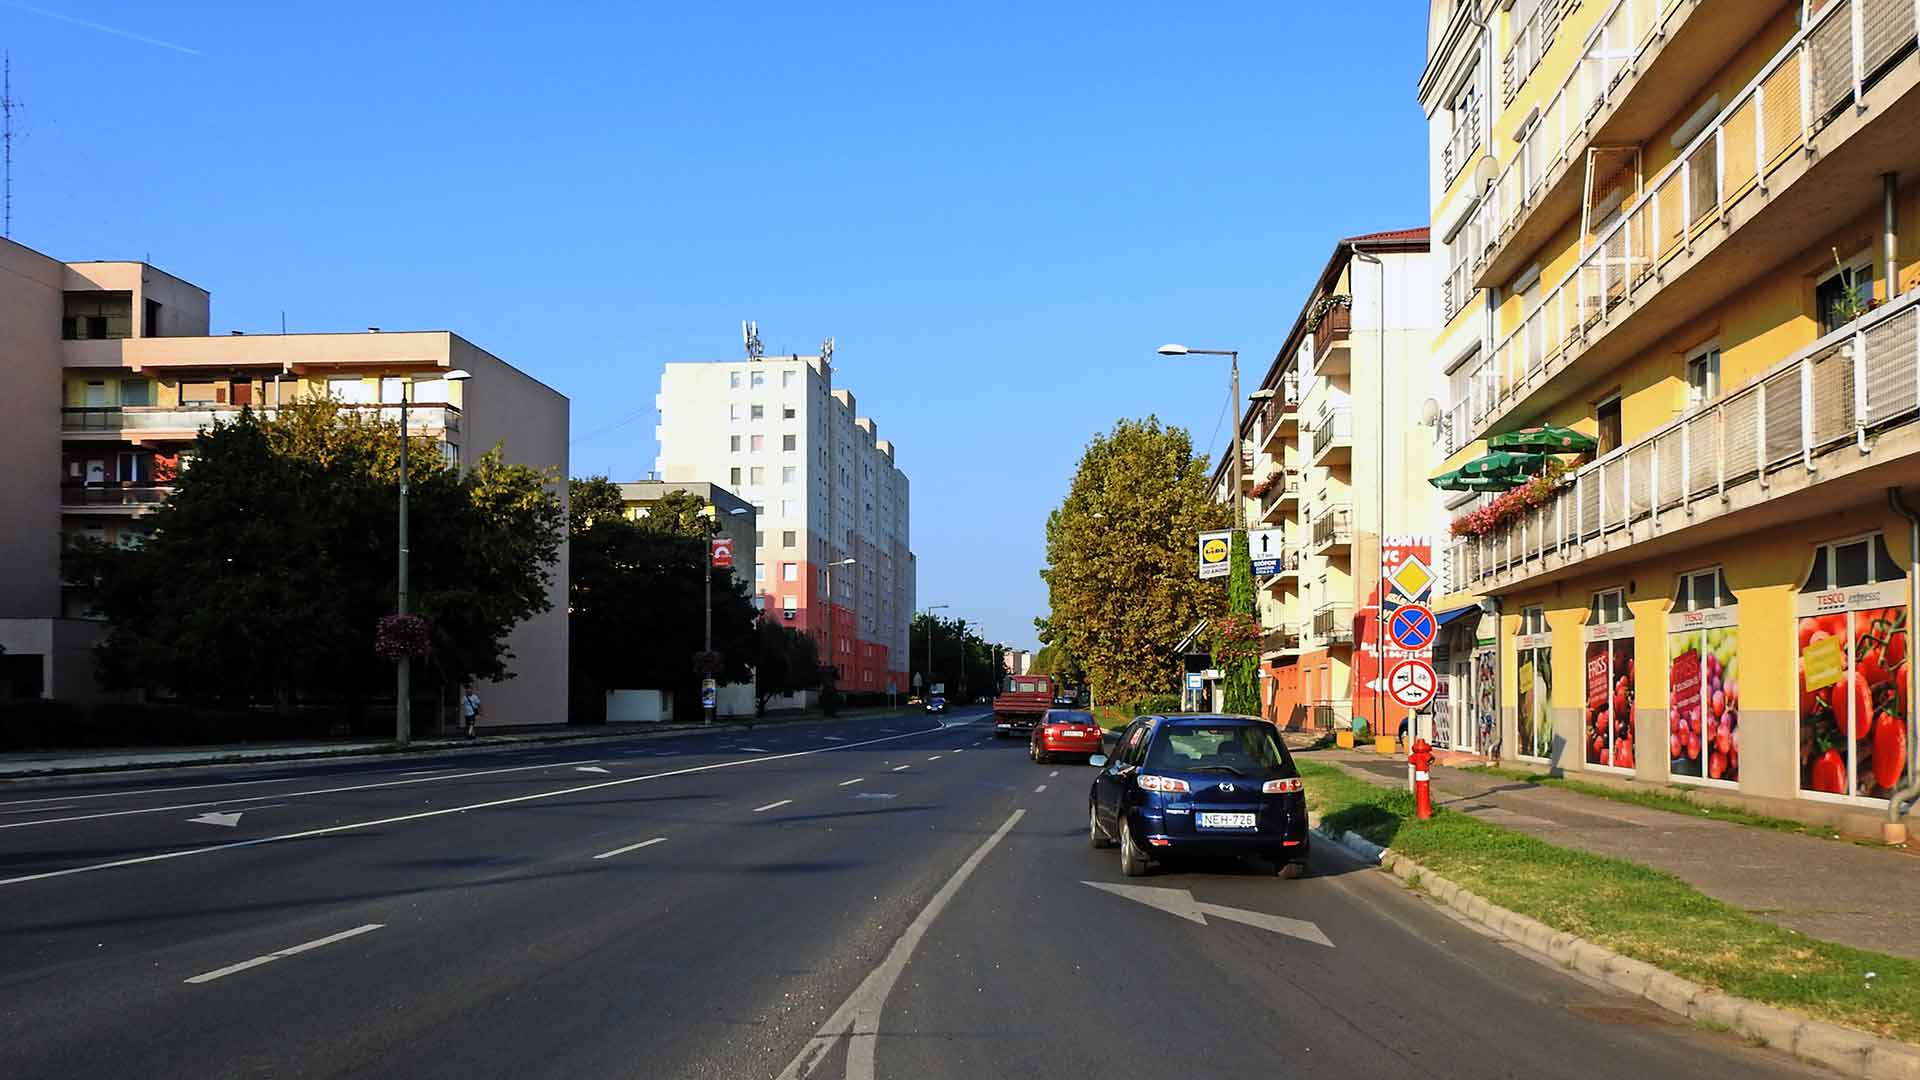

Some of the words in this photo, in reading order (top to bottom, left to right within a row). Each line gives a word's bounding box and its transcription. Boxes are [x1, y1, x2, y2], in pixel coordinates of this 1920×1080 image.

[1816, 592, 1845, 605] TESCO
[1684, 611, 1703, 622] TESCO
[1588, 655, 1607, 679] FRISS
[1204, 815, 1253, 825] NEH-726
